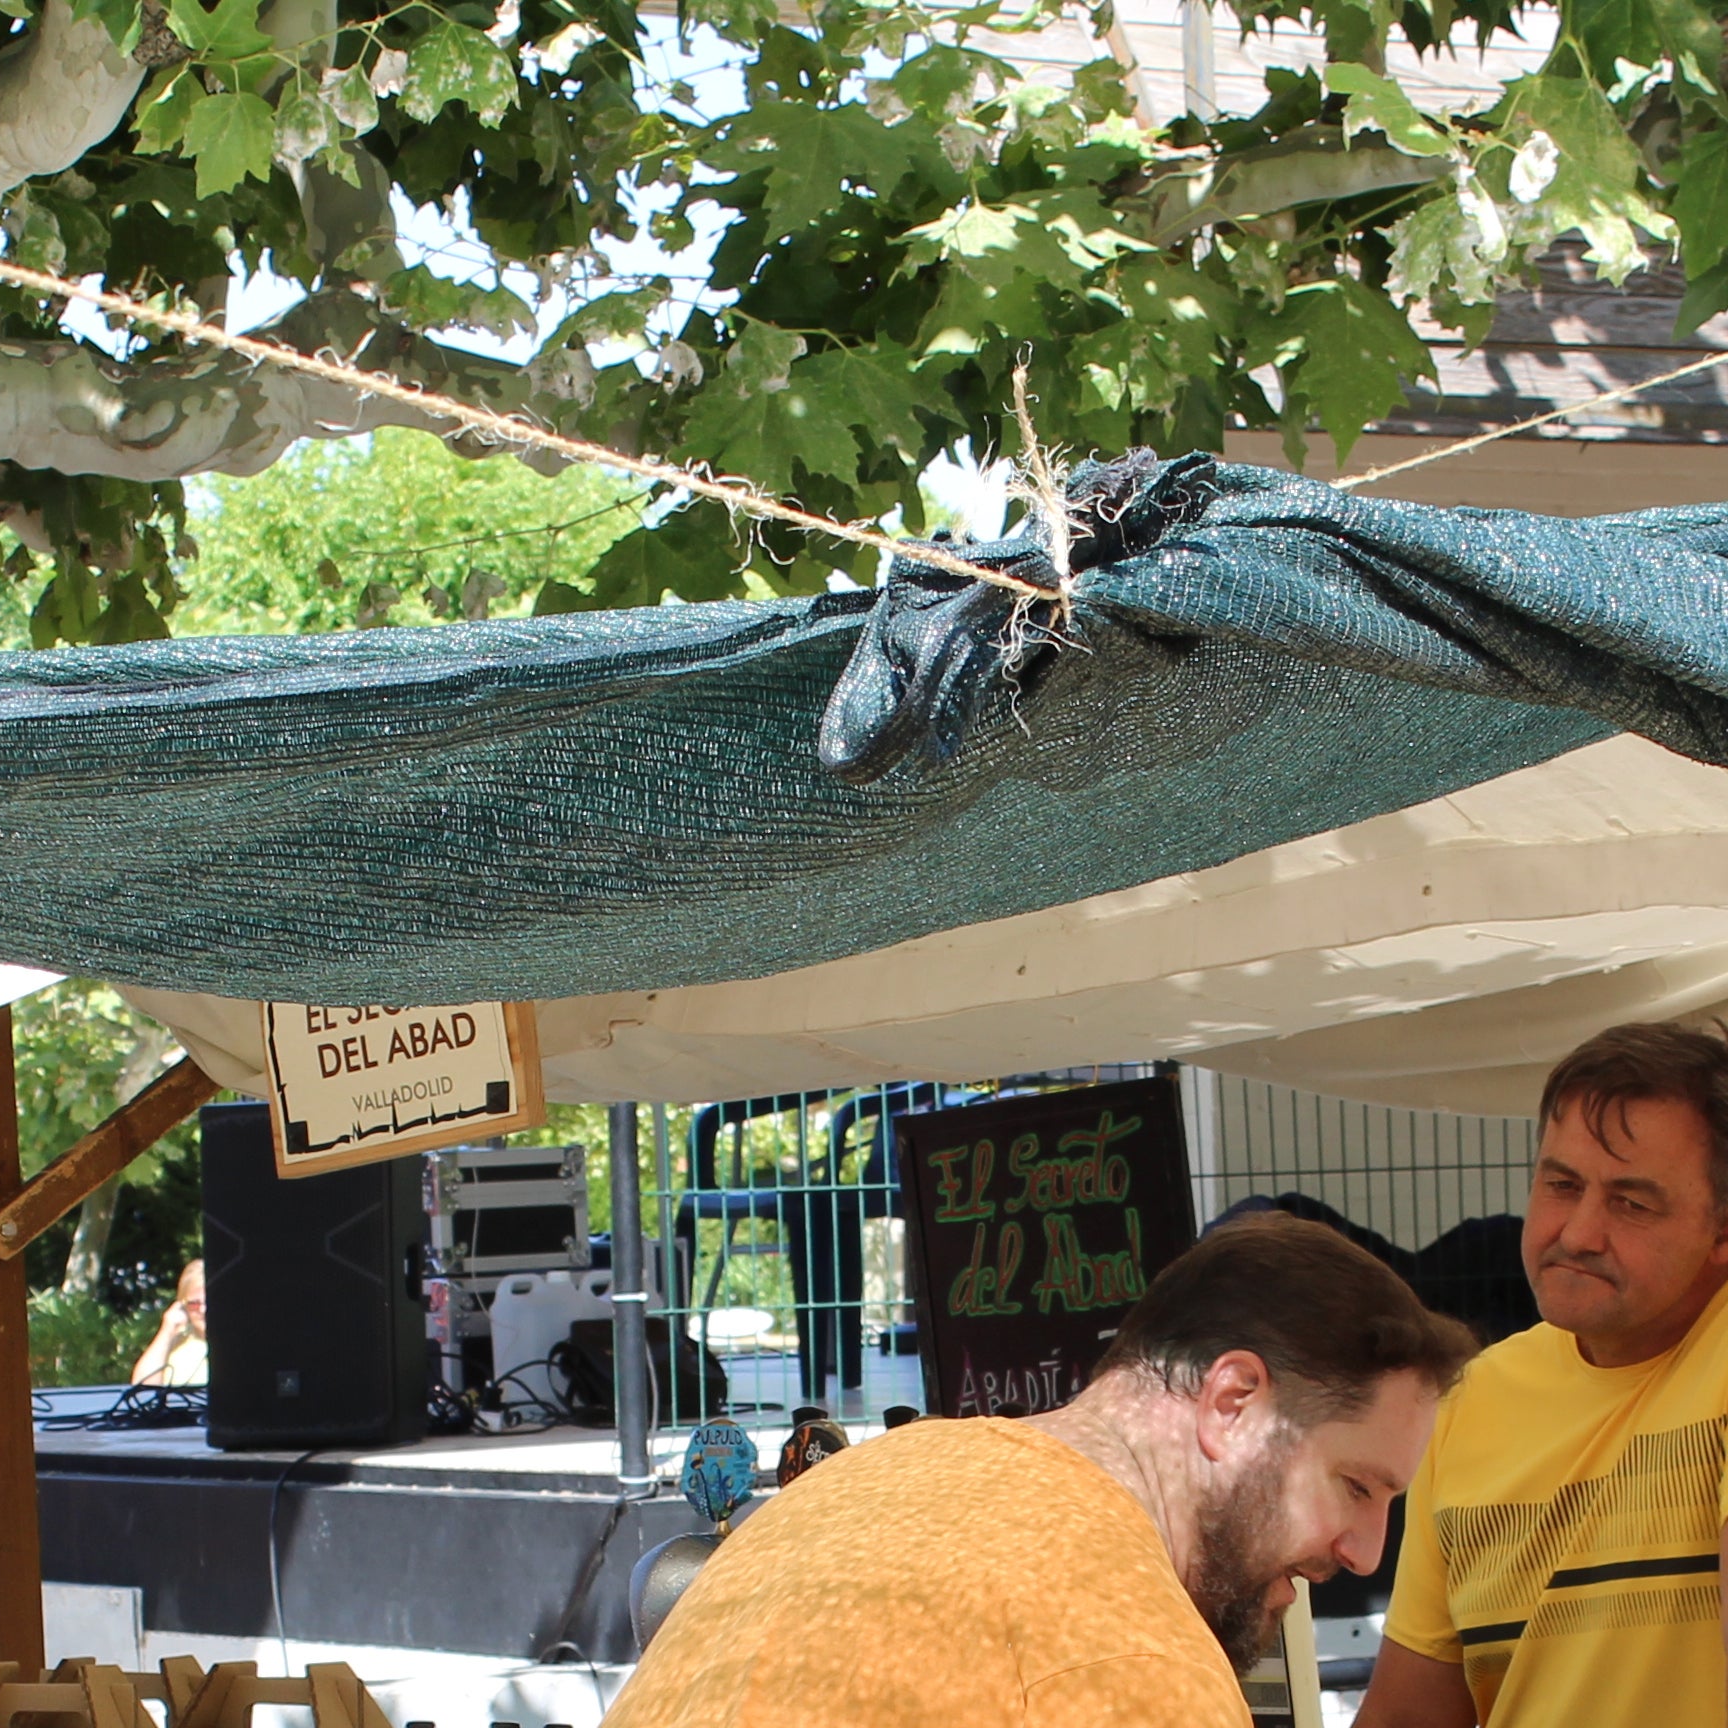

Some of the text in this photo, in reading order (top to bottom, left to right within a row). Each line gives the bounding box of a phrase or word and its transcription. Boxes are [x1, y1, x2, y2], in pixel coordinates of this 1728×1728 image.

[317, 1035, 378, 1079] DEL
[388, 1011, 477, 1064] ABAD
[352, 1076, 454, 1113] VALLADOLID
[928, 1138, 995, 1223] El
[949, 1221, 1023, 1316] del
[694, 1429, 744, 1446] PULPULO
